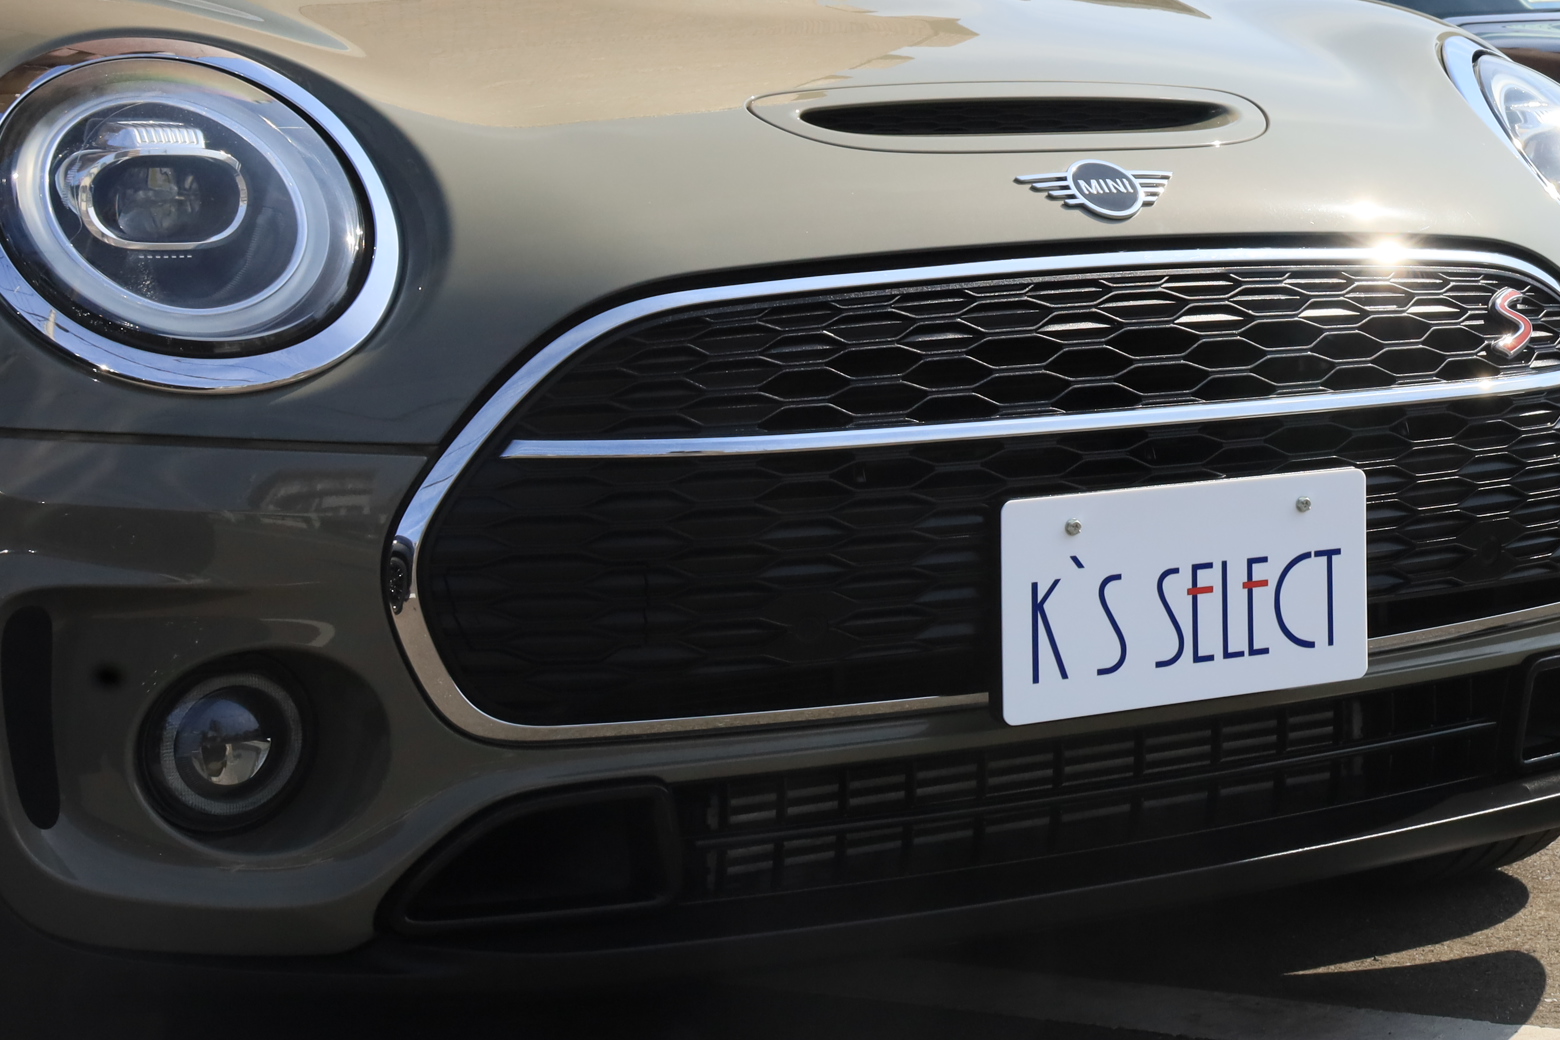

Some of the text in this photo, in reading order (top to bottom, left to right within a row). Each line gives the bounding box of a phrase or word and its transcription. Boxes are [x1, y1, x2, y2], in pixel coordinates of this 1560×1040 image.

[1077, 178, 1134, 195] MINI
[1487, 287, 1535, 359] S
[1154, 548, 1343, 669] SELECT
